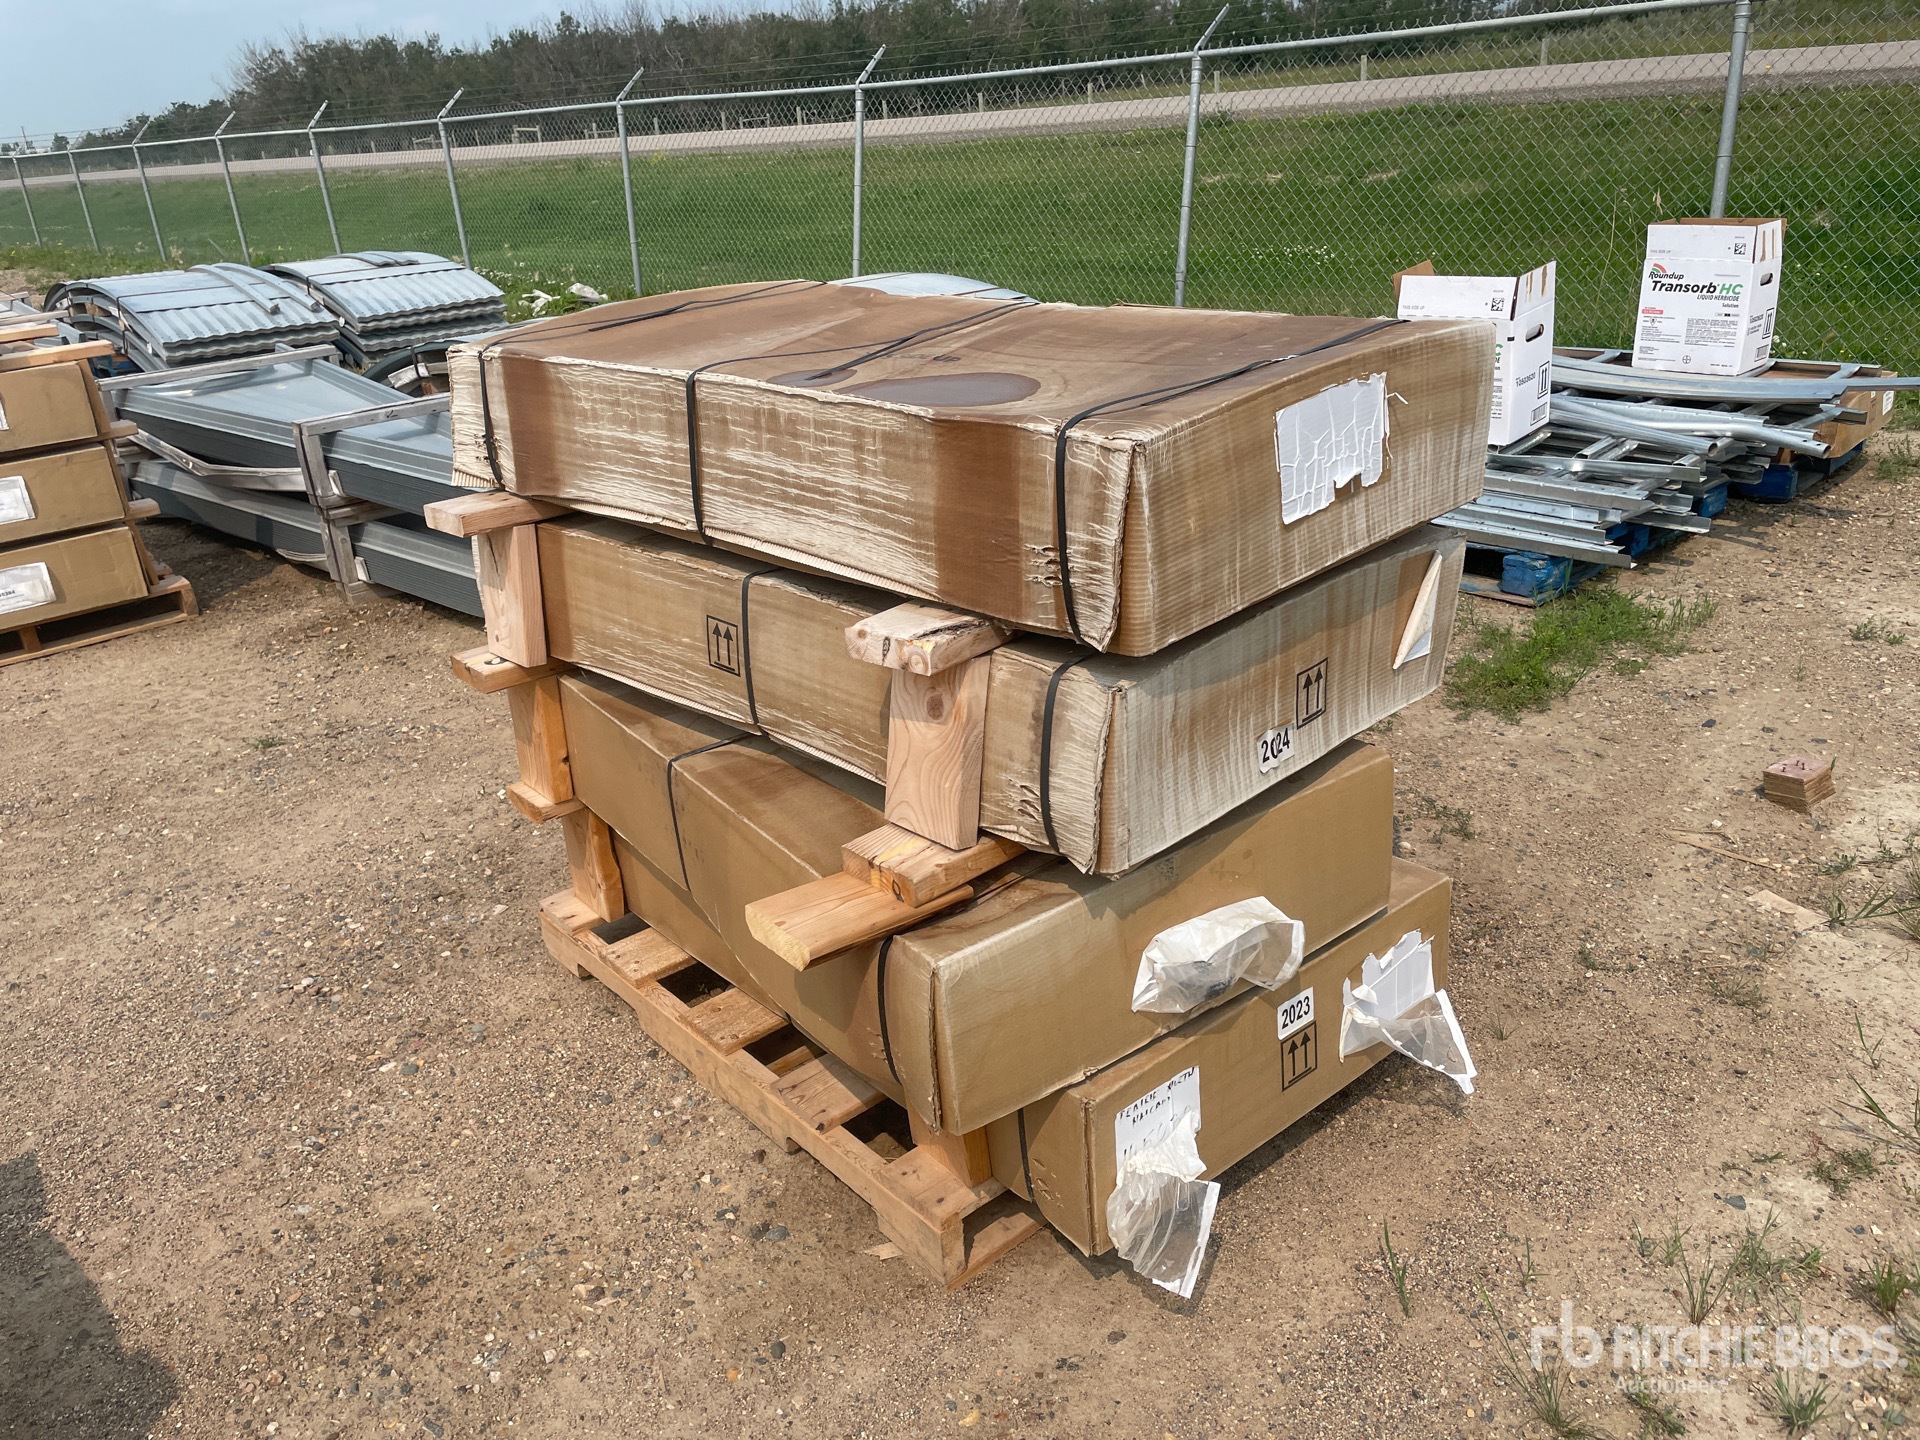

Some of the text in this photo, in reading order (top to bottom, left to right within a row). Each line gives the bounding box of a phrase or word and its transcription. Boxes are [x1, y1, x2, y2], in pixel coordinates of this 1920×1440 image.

[1648, 271, 1684, 281] Roundup
[1652, 280, 1743, 295] Transorb HC
[1261, 728, 1290, 764] 2024
[1282, 996, 1310, 1030] 2023
